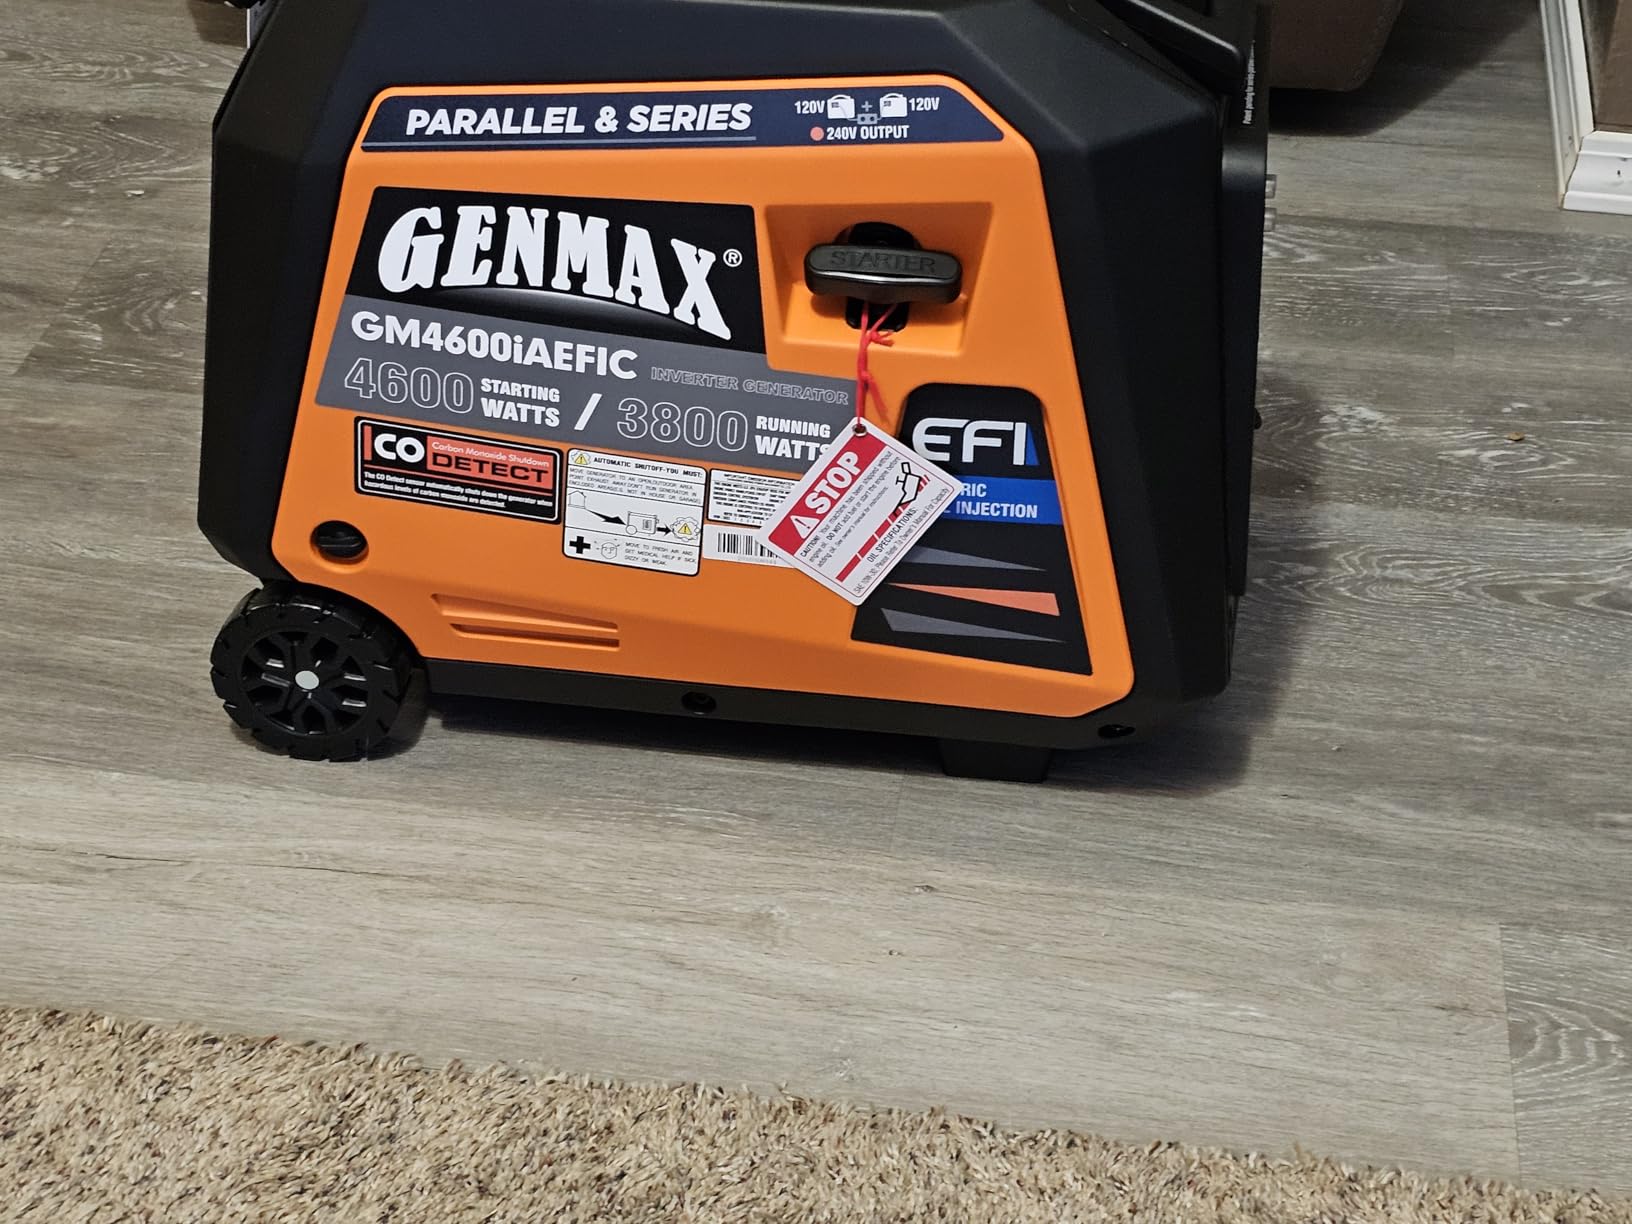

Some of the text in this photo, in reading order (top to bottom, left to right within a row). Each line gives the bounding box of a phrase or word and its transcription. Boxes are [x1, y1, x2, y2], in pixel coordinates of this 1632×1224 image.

[406, 103, 753, 135] PARALLEL & SERIES
[794, 100, 825, 114] 120V
[908, 97, 940, 111] 120V
[826, 125, 910, 140] 240V OUTPUT
[378, 205, 732, 341] GENMAX
[831, 250, 936, 274] STARTER
[351, 310, 638, 380] GM4600iAEFIC
[344, 358, 474, 414] 4600
[480, 378, 560, 402] STARTING
[650, 366, 848, 406] INVERTER GENERATOR
[480, 398, 560, 428] WATTS
[617, 398, 748, 452] 3800
[756, 416, 831, 438] RUNNING
[374, 433, 425, 464] CO
[432, 441, 550, 468] Carbon Monoxide Shutdown
[912, 417, 1027, 466] EFI
[432, 452, 548, 482] DETECT
[594, 457, 631, 466] AUTOMATIC
[806, 452, 861, 514] STOP
[819, 523, 830, 534] Your
[828, 504, 846, 524] machine
[845, 495, 854, 504] has
[852, 483, 864, 495] been
[862, 466, 879, 485] shipped
[876, 450, 892, 467] without
[956, 500, 1038, 518] INJECTION
[826, 532, 834, 540] DO
[832, 522, 842, 532] NOT
[867, 551, 878, 562] OIL
